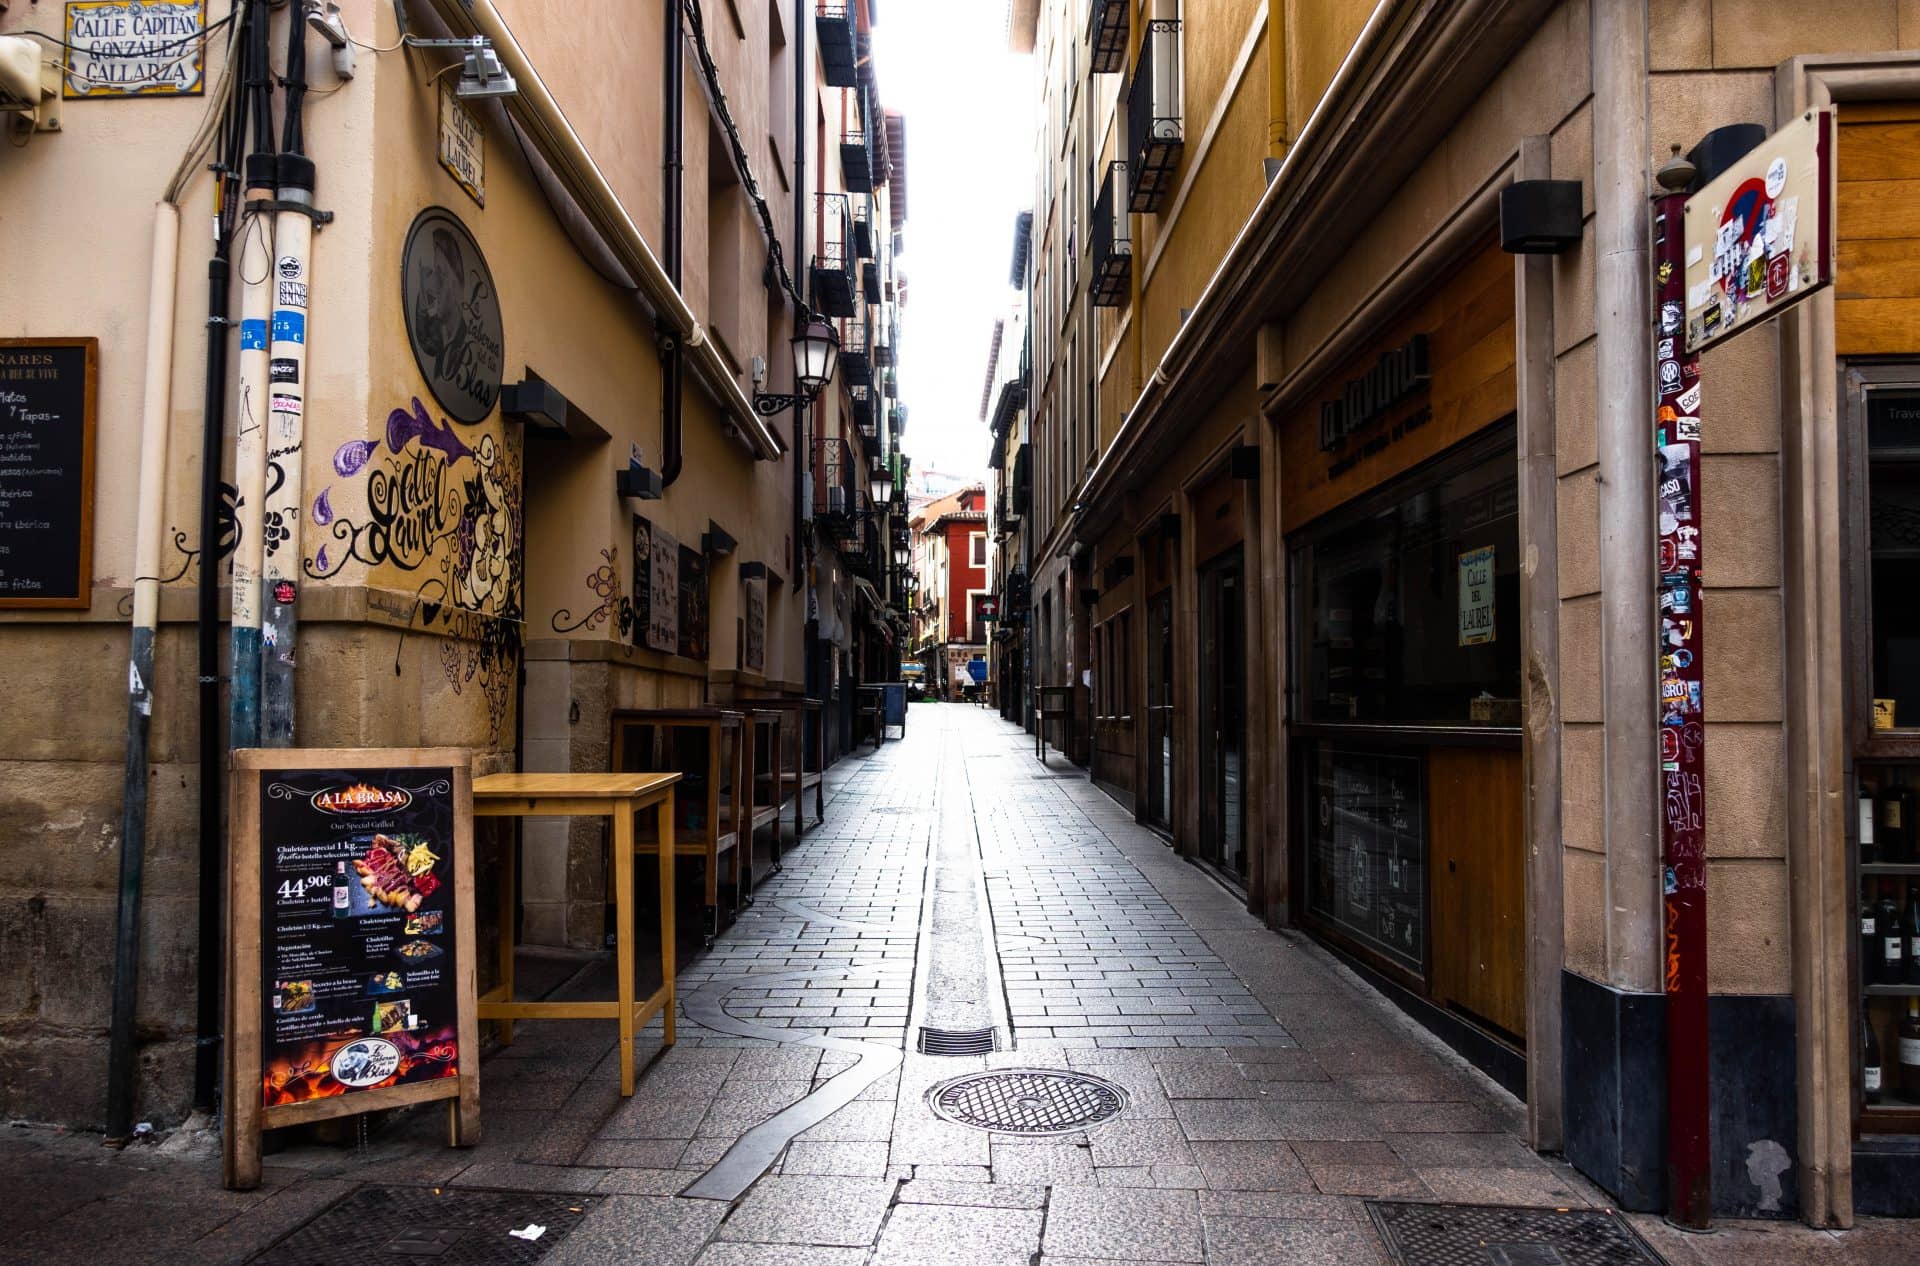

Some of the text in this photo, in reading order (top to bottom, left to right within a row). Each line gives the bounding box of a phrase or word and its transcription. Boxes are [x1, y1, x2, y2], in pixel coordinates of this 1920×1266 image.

[75, 13, 196, 38] CALLE CAPITÁN
[90, 36, 190, 61] GONZÁLEZ
[86, 62, 187, 83] GALLARZA
[453, 106, 475, 148] CALLE
[447, 133, 475, 185] LAUREL
[18, 408, 51, 425] Tapas
[1467, 569, 1488, 587] CALLE
[1472, 590, 1481, 602] DEL
[1463, 605, 1491, 630] LAUREL
[321, 791, 403, 805] A LA BRASA
[346, 821, 370, 831] Special
[371, 819, 394, 829] Grilled
[277, 845, 309, 853] Chuletón
[310, 843, 336, 852] especial
[337, 842, 342, 850] 1
[344, 841, 358, 852] kg.
[302, 852, 323, 860] botella
[323, 850, 350, 859] selección
[277, 874, 332, 898] 44,90€
